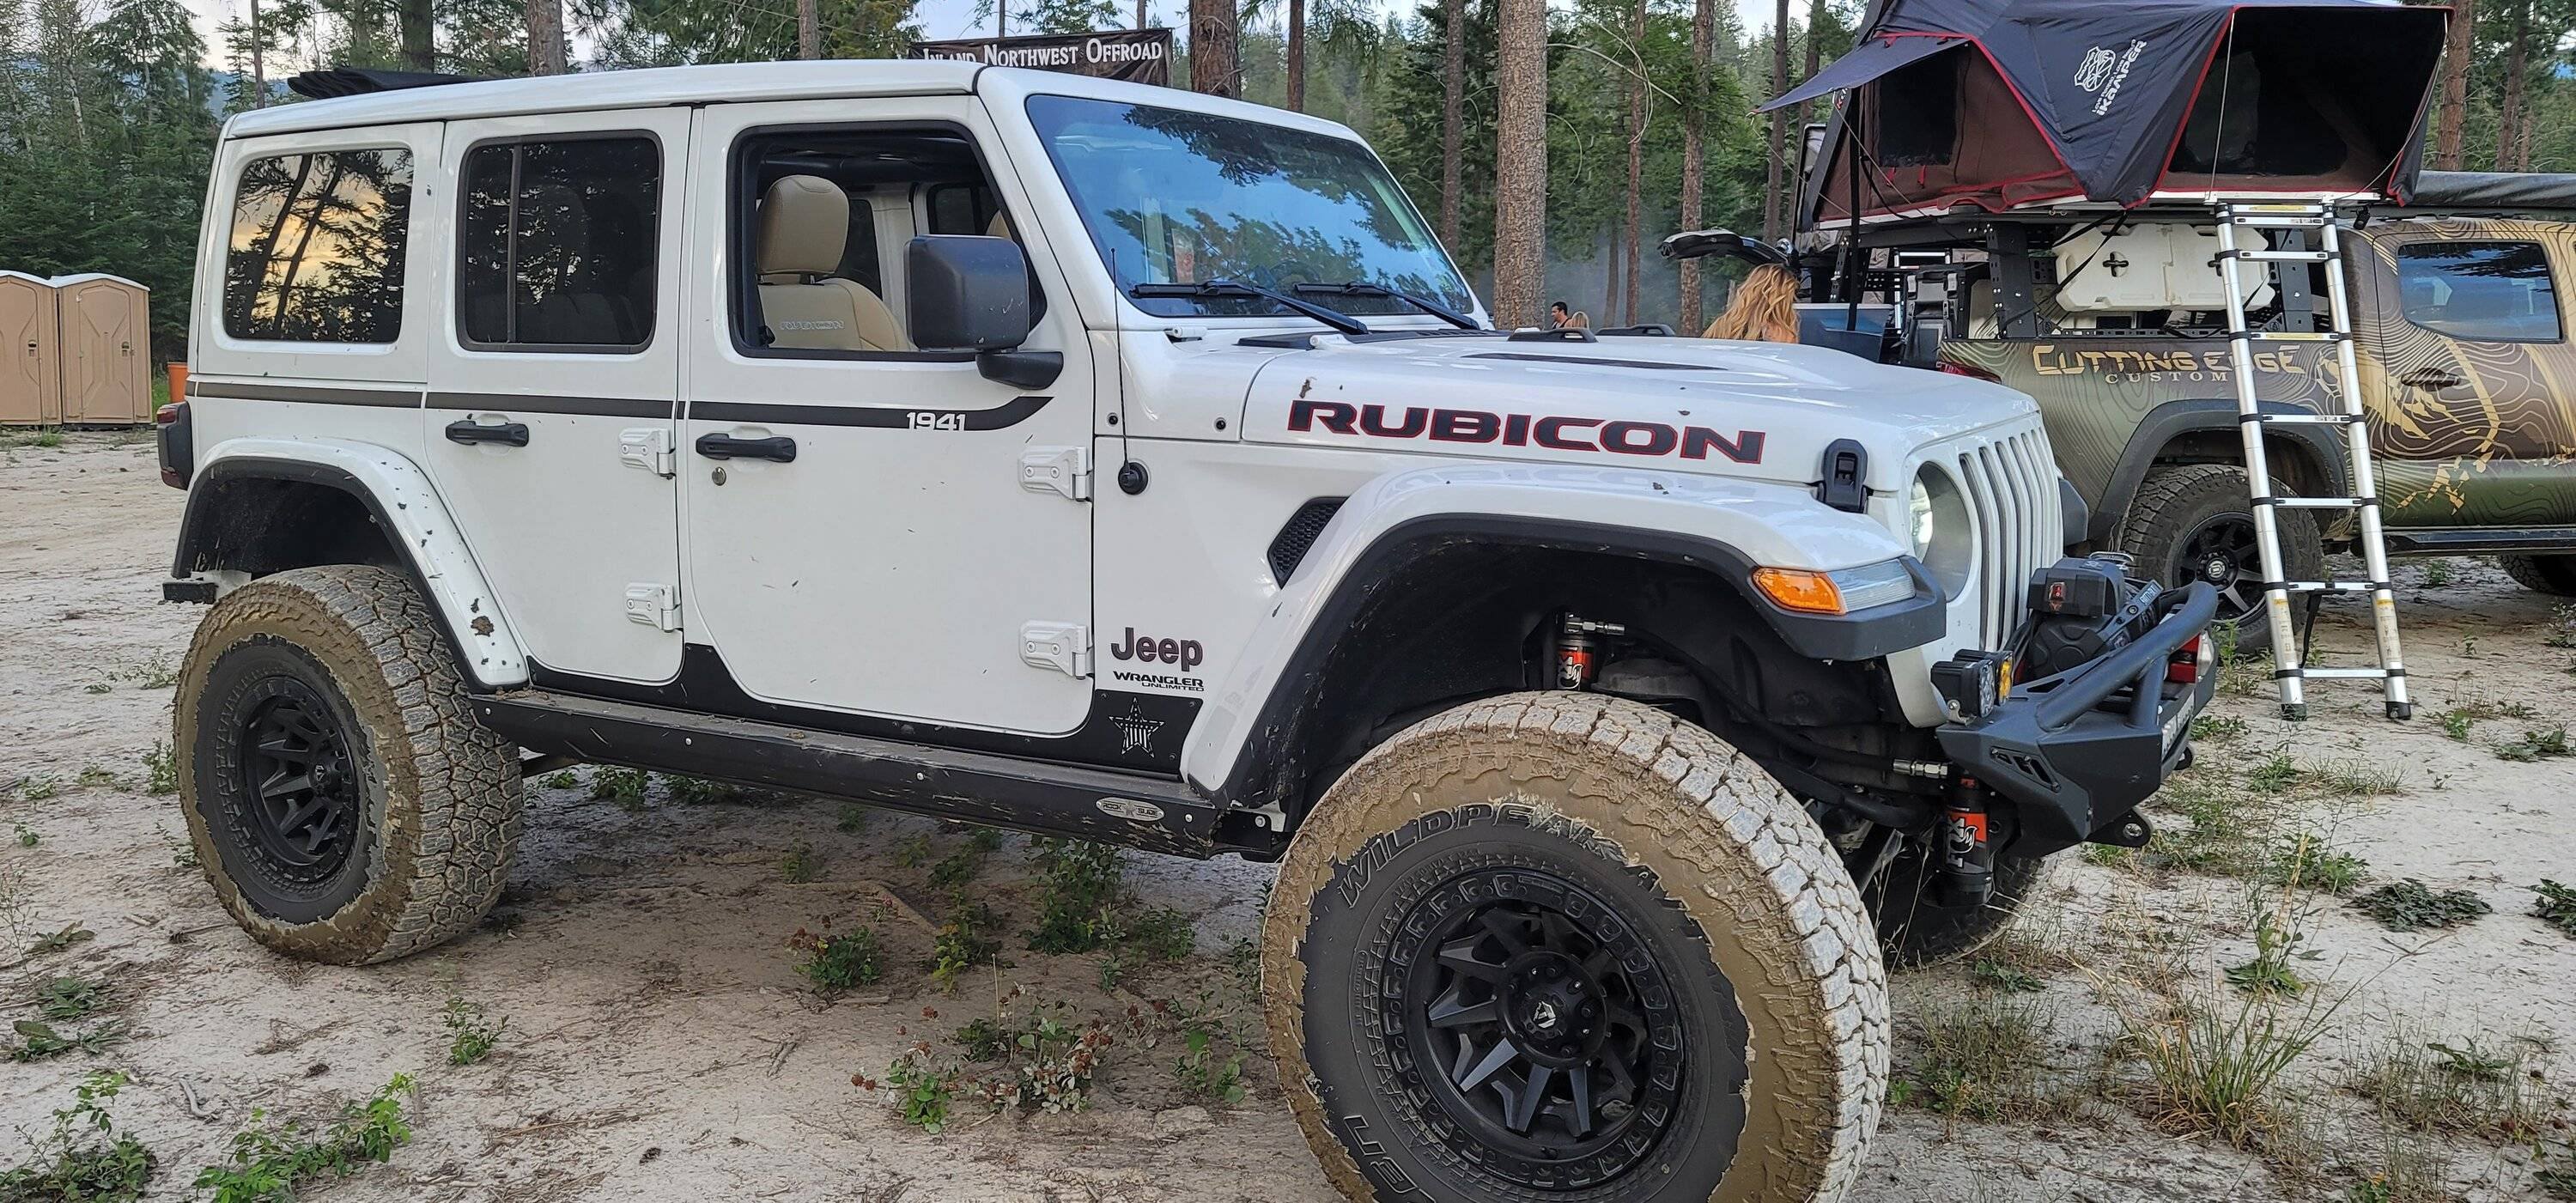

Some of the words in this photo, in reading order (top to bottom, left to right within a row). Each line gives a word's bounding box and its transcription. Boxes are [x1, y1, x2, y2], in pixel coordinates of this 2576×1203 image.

[2032, 345, 2198, 375] CUTTING
[2202, 344, 2307, 374] EGE
[907, 411, 966, 431] 1941
[1287, 399, 1766, 465] RUBICON
[1111, 627, 1203, 672] Jeep
[1113, 671, 1204, 687] WRANGLER
[1141, 682, 1205, 692] UNLIMITED
